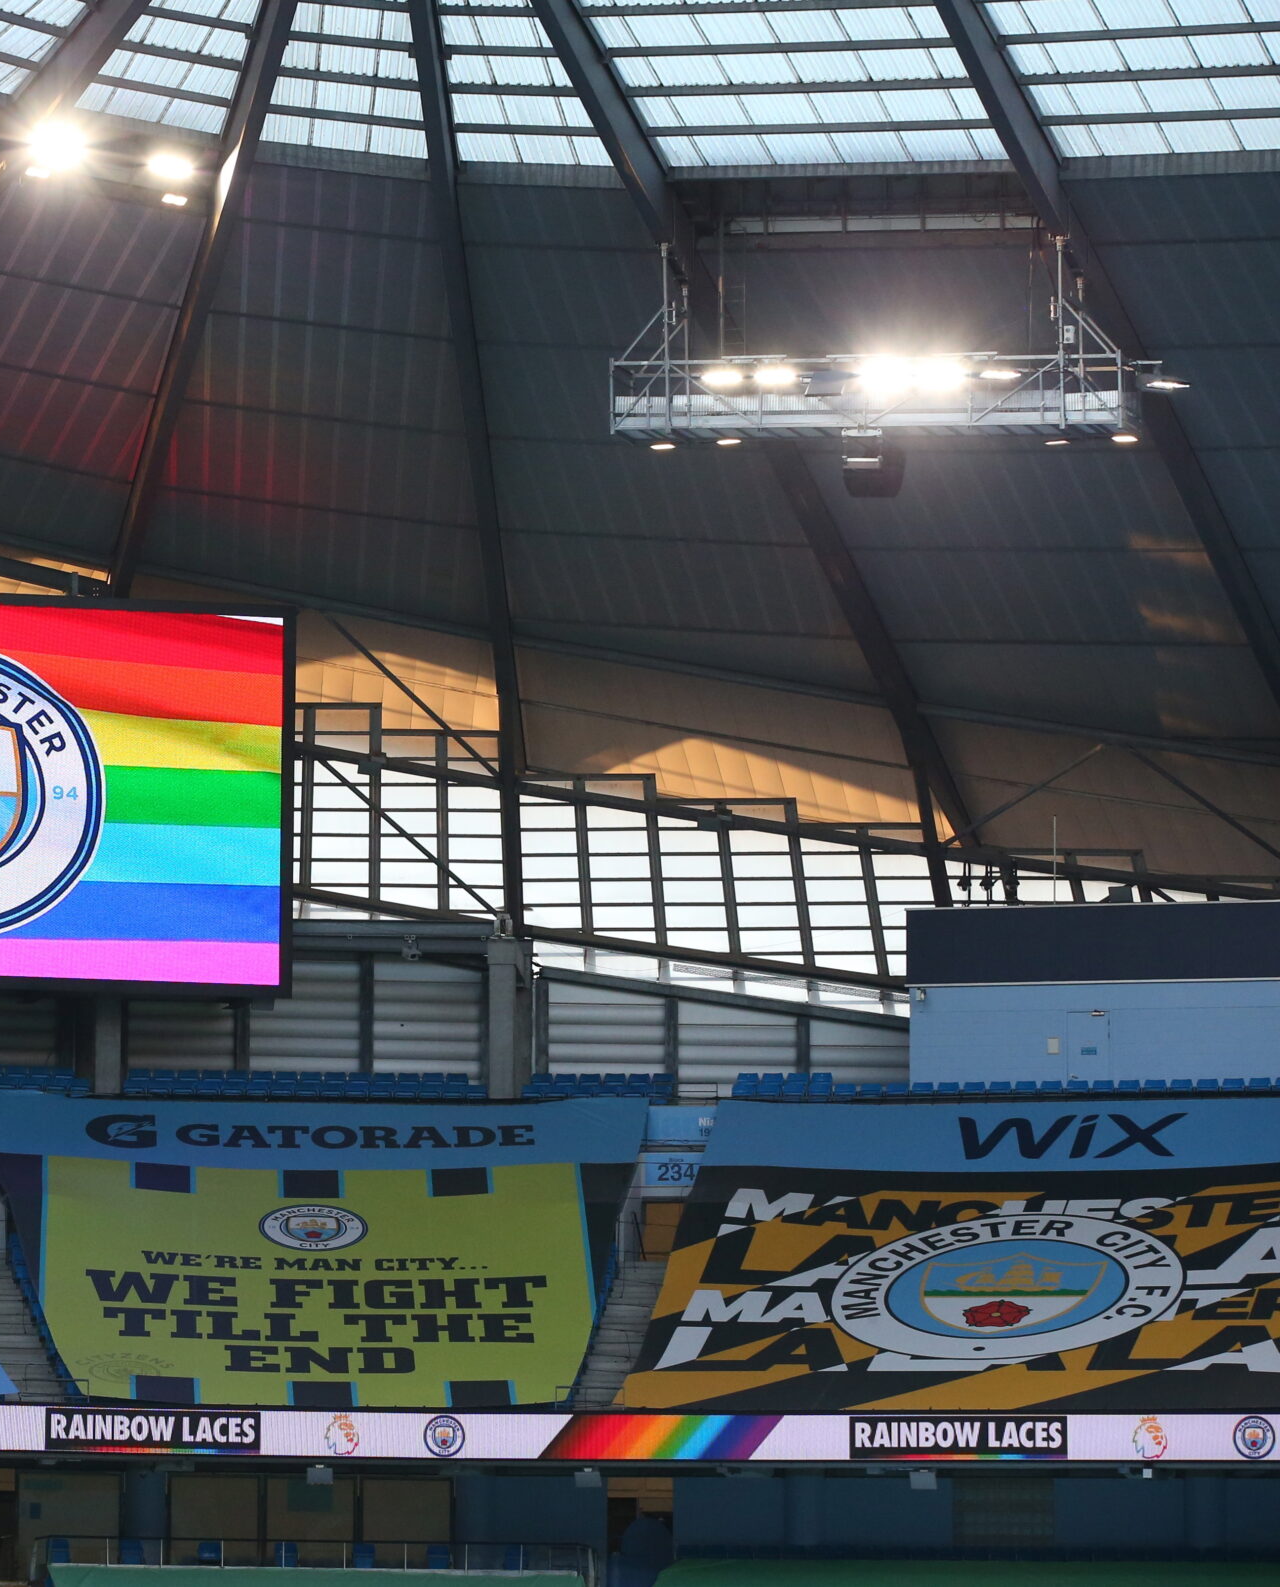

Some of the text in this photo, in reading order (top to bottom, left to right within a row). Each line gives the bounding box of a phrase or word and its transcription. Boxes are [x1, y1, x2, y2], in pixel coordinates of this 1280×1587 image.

[52, 785, 79, 801] 94
[175, 1123, 537, 1149] GATORADE
[658, 1163, 696, 1181] 234
[271, 1207, 355, 1223] MANCHESTER
[274, 1257, 363, 1271] MAN
[840, 1219, 1075, 1321] MANCHESTER
[1095, 1230, 1172, 1270] CITY
[85, 1269, 548, 1310] WE FIGHT
[102, 1306, 535, 1343] TILL THE
[224, 1344, 416, 1373] END
[49, 1412, 256, 1444] RAINBOW LACES
[854, 1420, 1063, 1449] RAINBOW LACES
